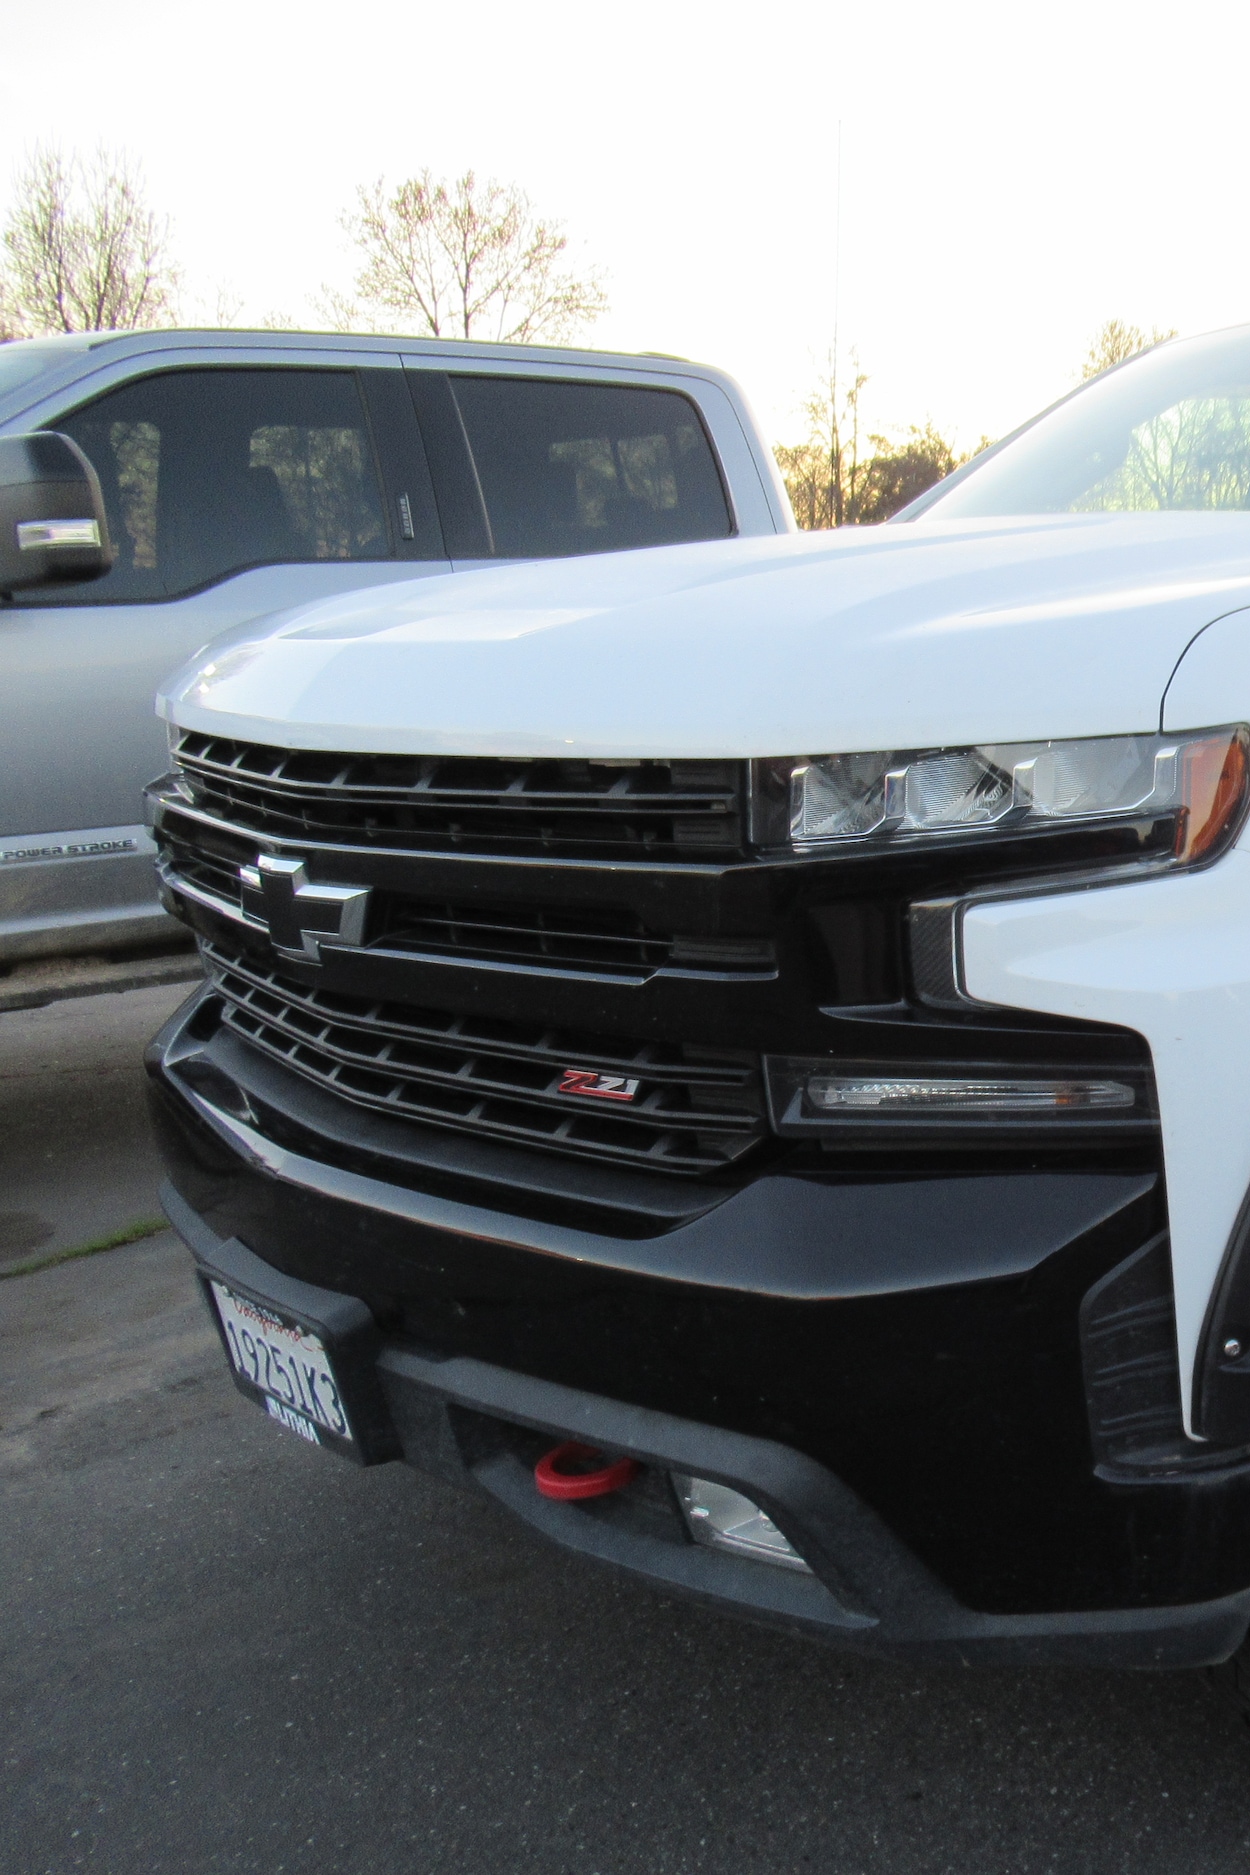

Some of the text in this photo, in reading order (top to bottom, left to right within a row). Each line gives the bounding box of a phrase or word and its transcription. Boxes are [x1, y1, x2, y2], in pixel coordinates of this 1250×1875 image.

[3, 839, 134, 860] POWER STROKE
[558, 1069, 640, 1101] Z71
[227, 1320, 347, 1436] 19251K3
